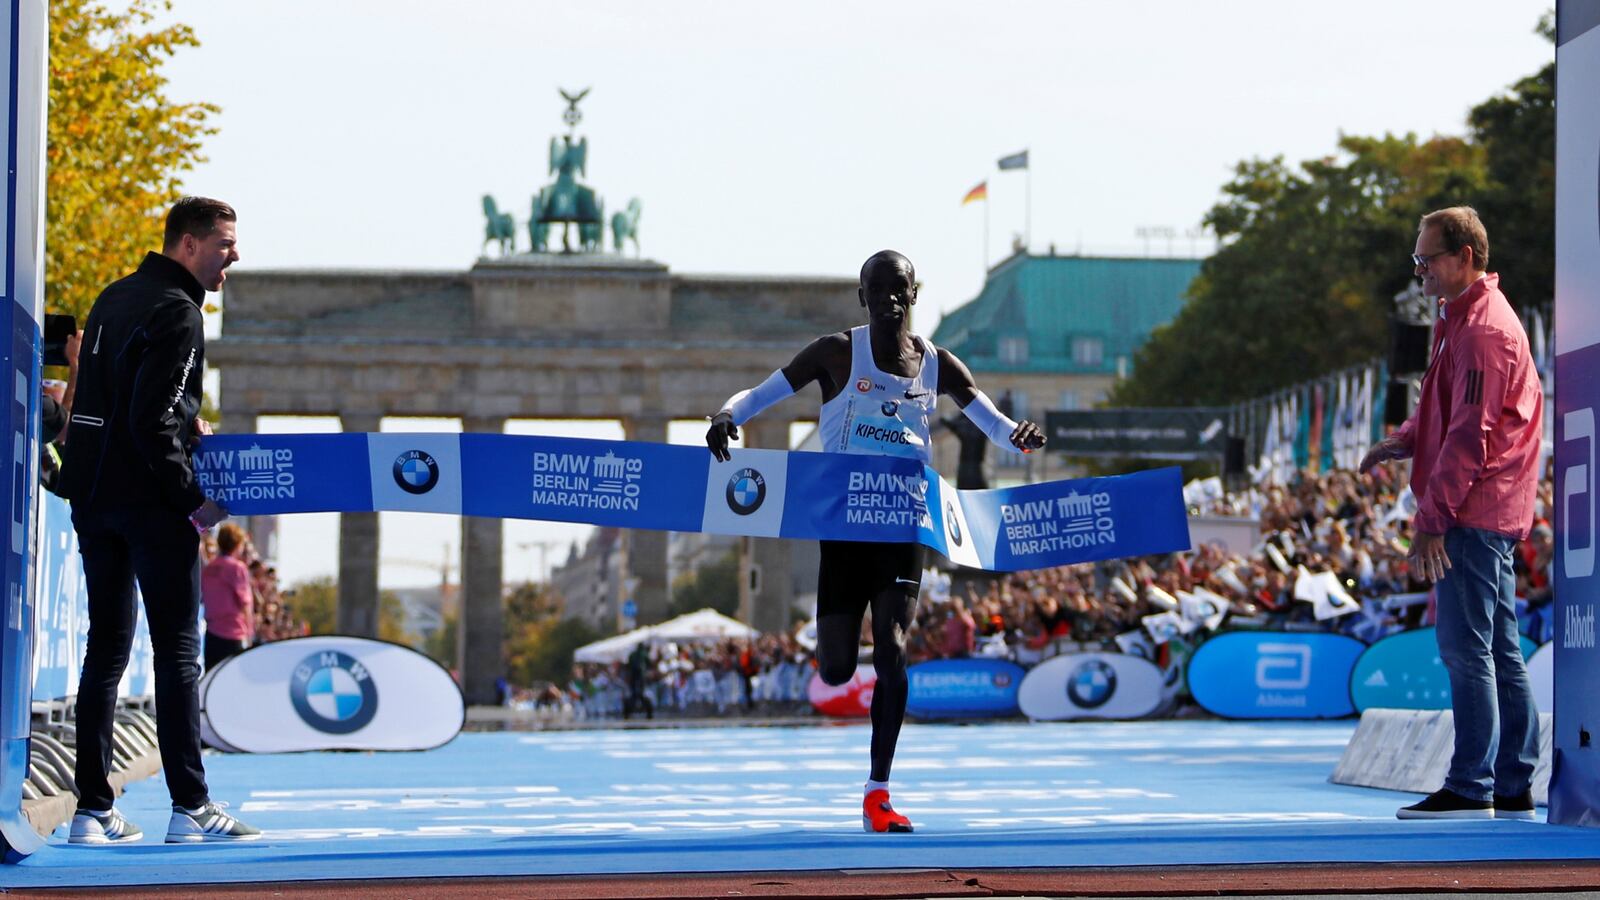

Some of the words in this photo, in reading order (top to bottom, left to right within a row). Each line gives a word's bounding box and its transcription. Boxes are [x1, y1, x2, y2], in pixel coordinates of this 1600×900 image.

[874, 383, 886, 392] NN
[191, 450, 235, 471] MW
[533, 452, 591, 475] BMW
[194, 471, 237, 487] RLIN
[275, 448, 295, 499] 2018
[532, 474, 590, 492] BERLIN
[848, 471, 906, 493] BMW
[204, 485, 275, 502] RATHON
[623, 458, 643, 511] 2018
[532, 490, 622, 511] MARATHON
[847, 493, 910, 509] BERLIN
[1001, 499, 1054, 525] BMW
[1092, 491, 1117, 545] 2018
[1006, 520, 1058, 541] BERLIN
[1009, 532, 1099, 557] MARATHON
[1563, 603, 1596, 649] Abbott
